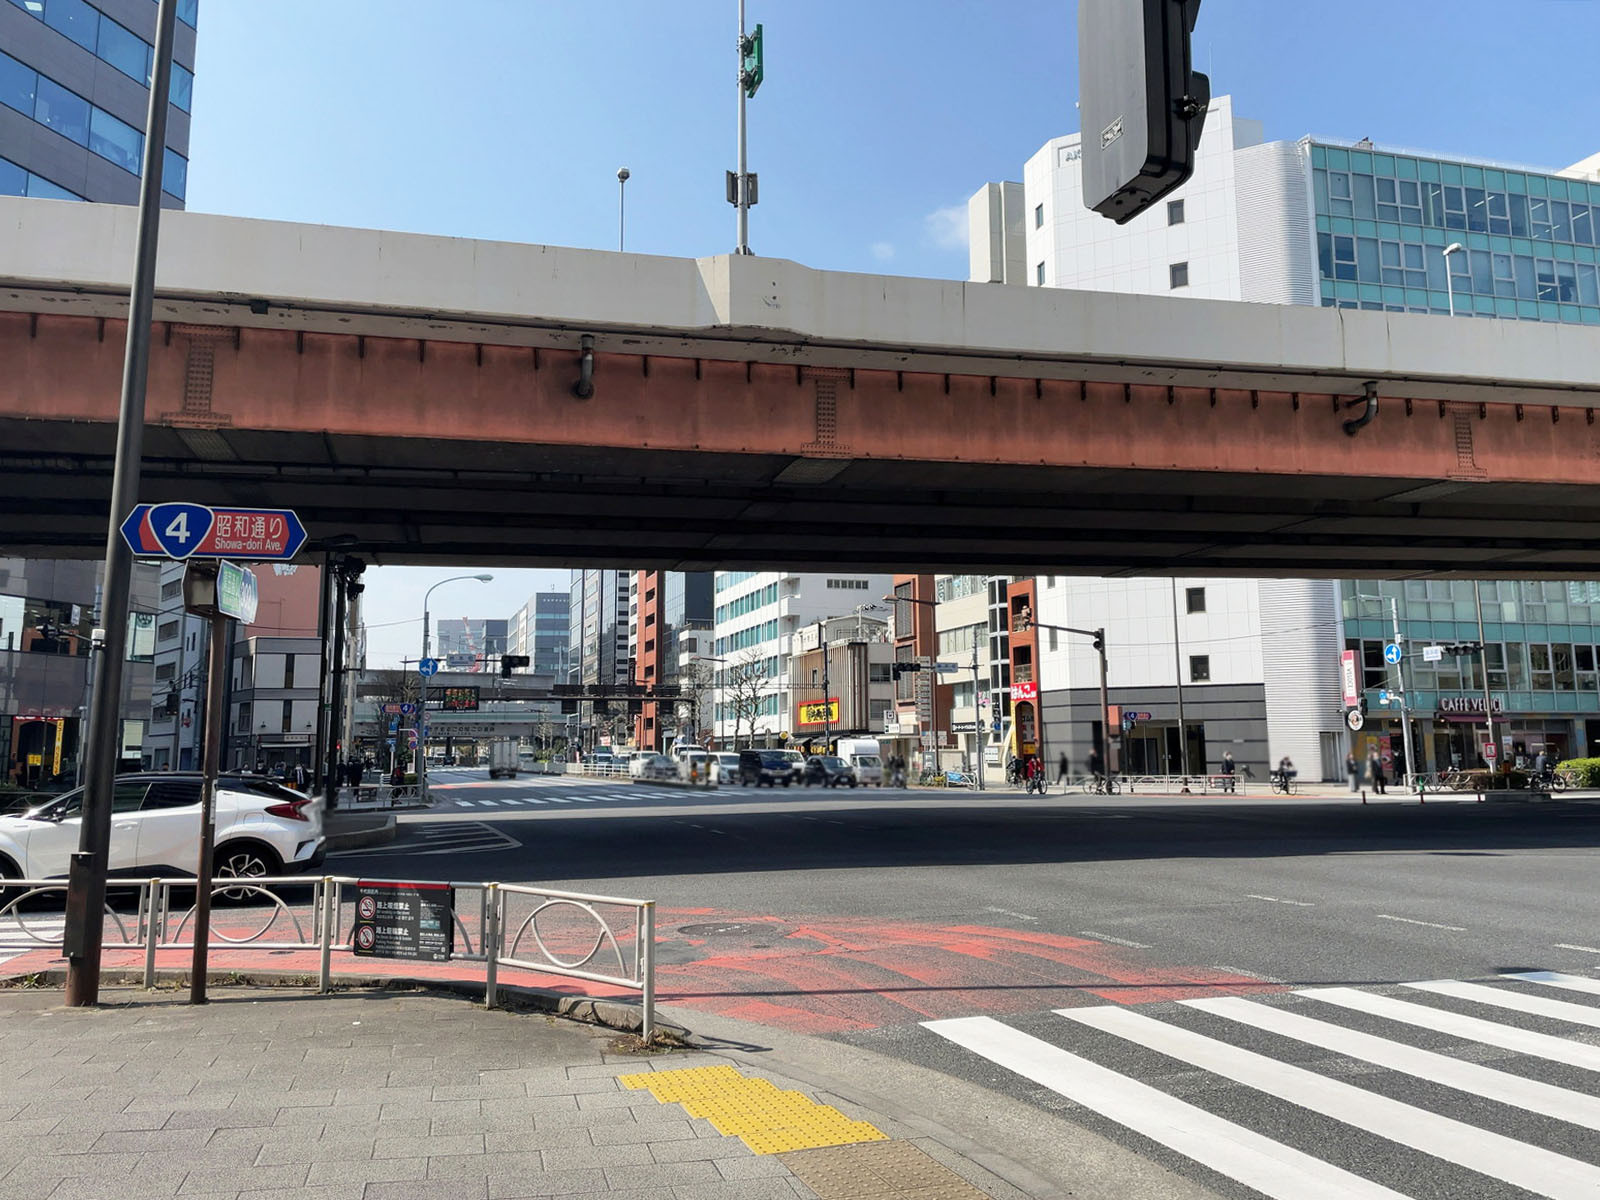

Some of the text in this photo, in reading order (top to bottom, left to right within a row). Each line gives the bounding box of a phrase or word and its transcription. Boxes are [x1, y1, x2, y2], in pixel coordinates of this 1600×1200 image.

[165, 512, 190, 543] 4
[217, 515, 282, 538] 昭和通り
[215, 538, 281, 551] Showa-dori Ave.
[1471, 697, 1503, 711] VELCE
